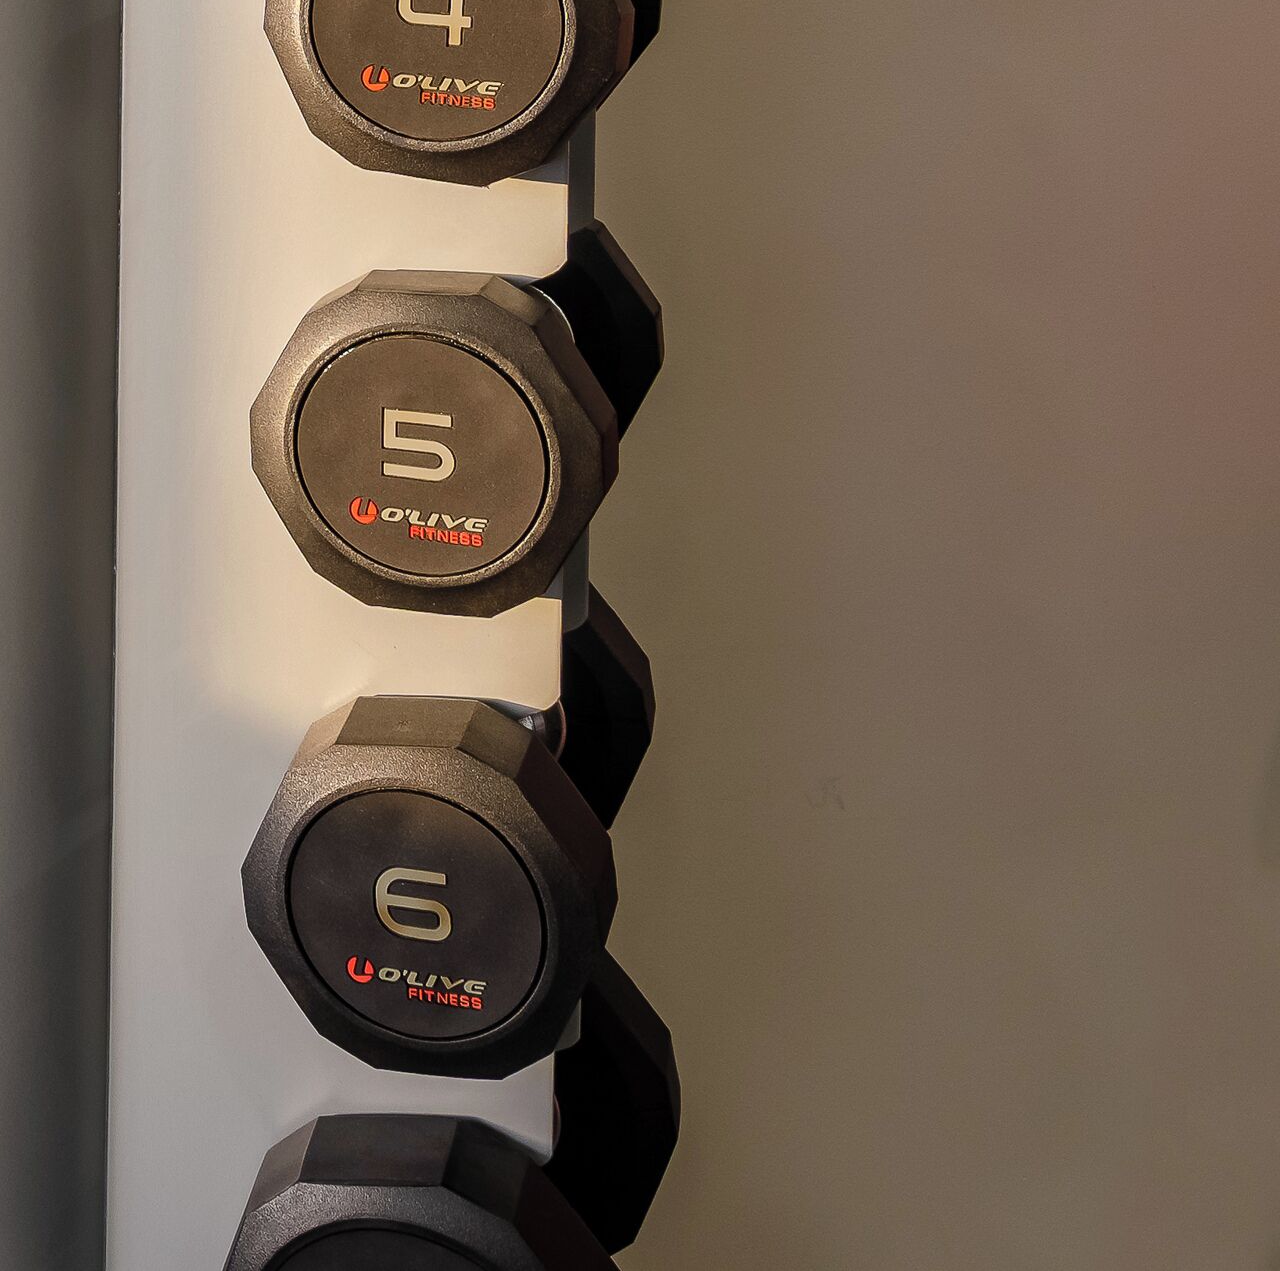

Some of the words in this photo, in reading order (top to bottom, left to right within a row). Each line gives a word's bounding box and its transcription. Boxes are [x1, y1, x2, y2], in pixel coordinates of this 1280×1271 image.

[392, 73, 503, 96] O'LIVE
[420, 91, 495, 110] FITNESS
[382, 407, 455, 481] 5
[381, 507, 488, 532] O'LIVE
[409, 525, 483, 547] FITNESS
[376, 867, 451, 941] 6
[379, 967, 487, 995] O'LIVE
[408, 988, 483, 1010] FITNESS
